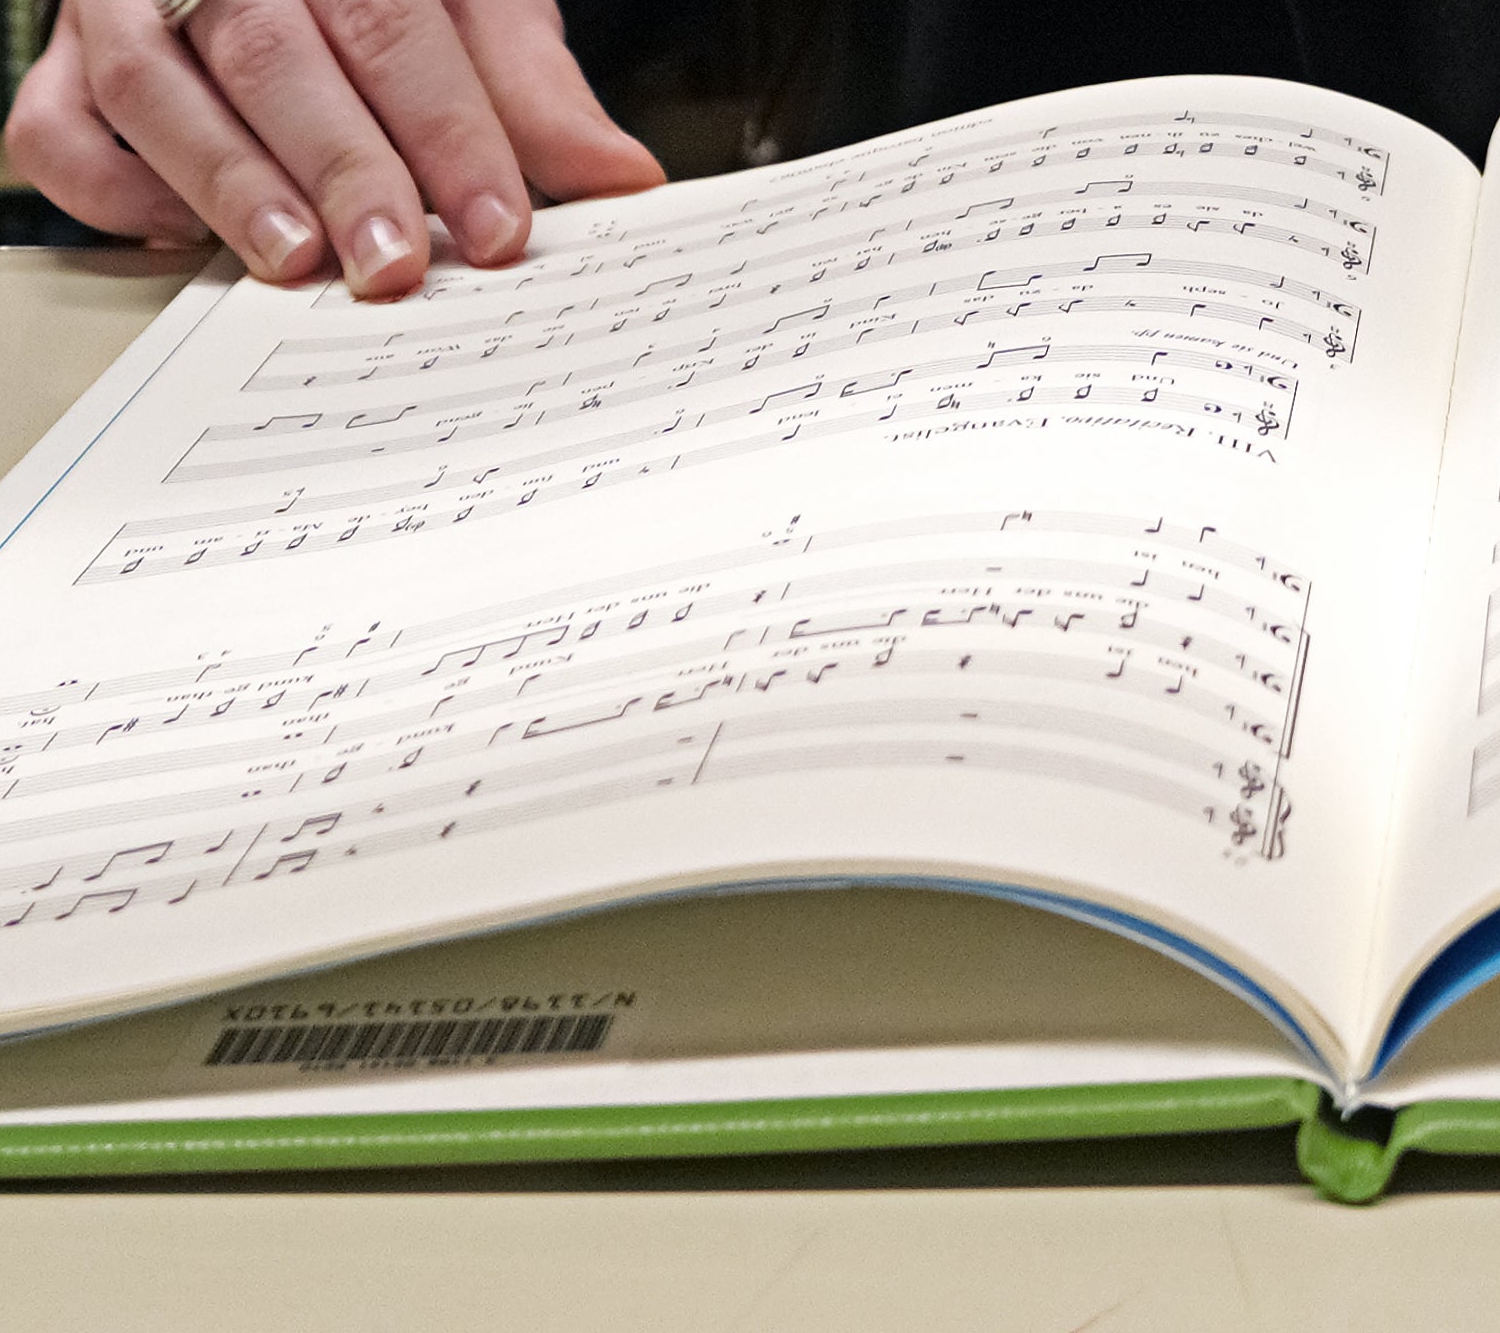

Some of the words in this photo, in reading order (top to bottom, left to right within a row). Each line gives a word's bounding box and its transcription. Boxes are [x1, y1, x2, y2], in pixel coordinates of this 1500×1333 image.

[1071, 284, 1094, 293] da
[1180, 283, 1227, 296] seph
[849, 313, 896, 329] Kind
[1259, 347, 1299, 370] Und
[1020, 373, 1043, 382] ka
[1074, 372, 1101, 381] sie
[1131, 373, 1176, 386] Und
[929, 382, 973, 392] men
[777, 409, 820, 426] lend
[882, 419, 1048, 443] Evangelist.
[1060, 415, 1196, 438] Recitativo.
[1209, 432, 1279, 465] VIII.
[581, 458, 620, 474] und
[458, 488, 495, 503] den
[346, 514, 370, 525] de
[193, 535, 225, 547] am
[123, 544, 164, 558] und
[395, 723, 454, 746] kund
